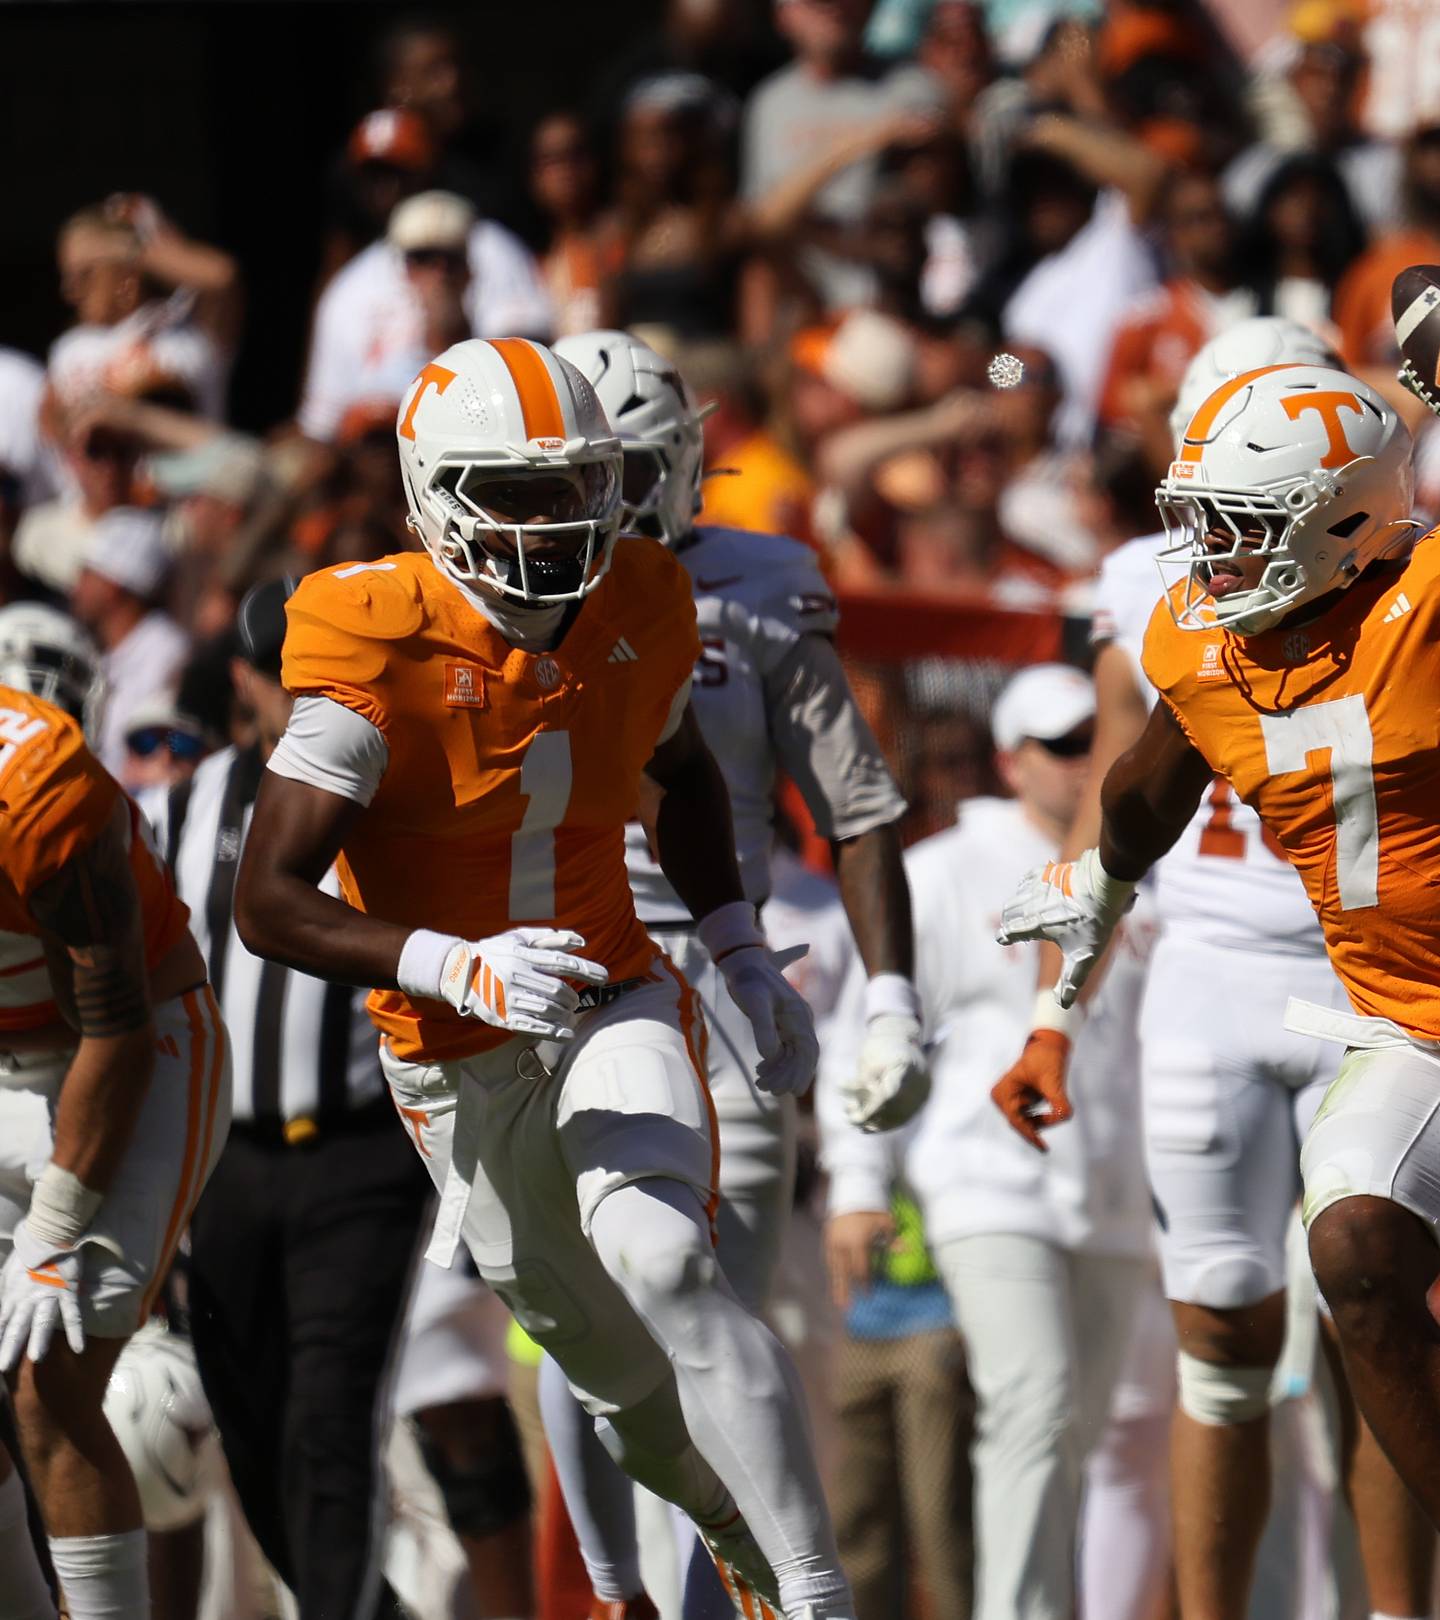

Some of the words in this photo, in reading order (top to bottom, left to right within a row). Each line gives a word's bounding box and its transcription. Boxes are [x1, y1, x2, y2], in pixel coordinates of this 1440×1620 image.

[399, 362, 458, 441] T
[1280, 391, 1363, 468] T
[447, 694, 480, 703] HORIZON
[454, 687, 473, 695] FIRST
[508, 730, 572, 921] 1
[1259, 693, 1379, 911] 7
